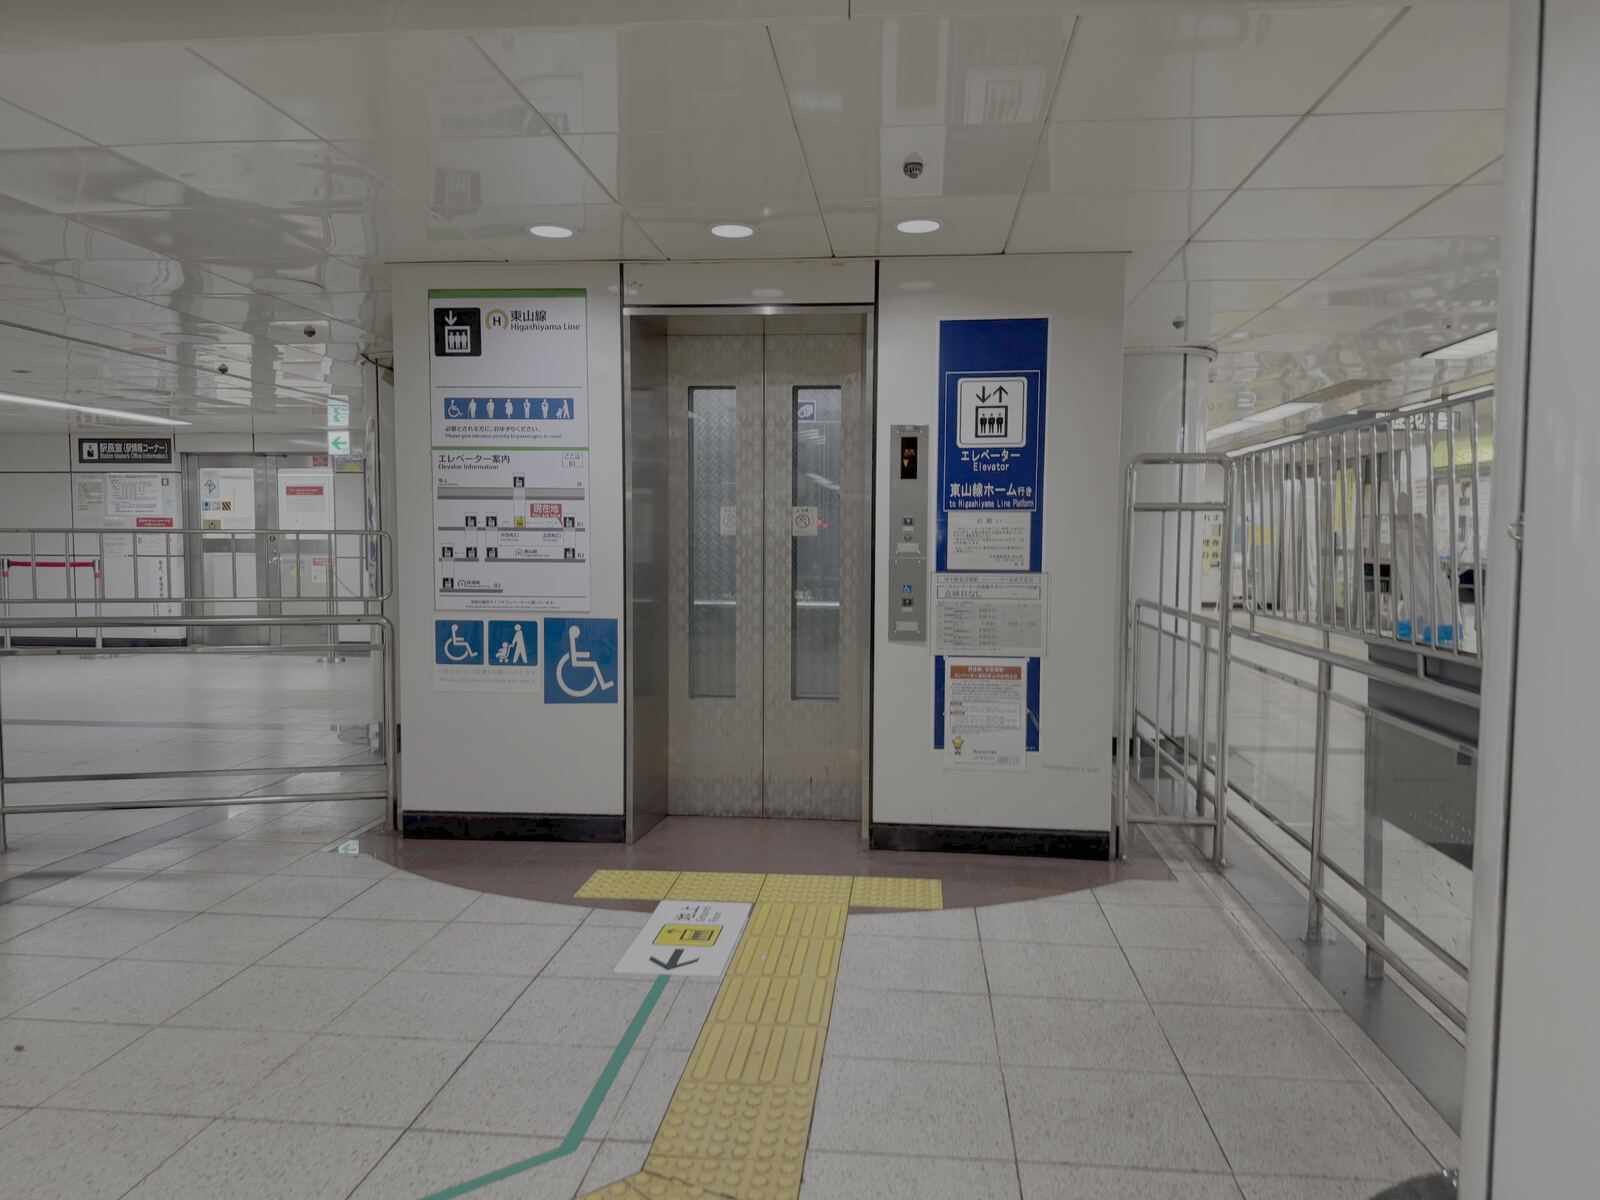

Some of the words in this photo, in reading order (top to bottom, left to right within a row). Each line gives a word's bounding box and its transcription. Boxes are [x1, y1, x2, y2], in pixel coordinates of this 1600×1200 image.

[510, 310, 547, 322] 東山線
[510, 323, 562, 332] Higashiyama
[438, 454, 511, 464] エレベーター案内
[961, 448, 1021, 462] エレベーター
[973, 462, 1010, 472] Elevator
[949, 482, 1033, 498] 東山線ホーム行き
[533, 504, 560, 513] 現在地
[949, 500, 956, 508] to
[958, 499, 995, 509] Higashiyama
[996, 499, 1011, 508] Line
[1012, 498, 1034, 508] Platform
